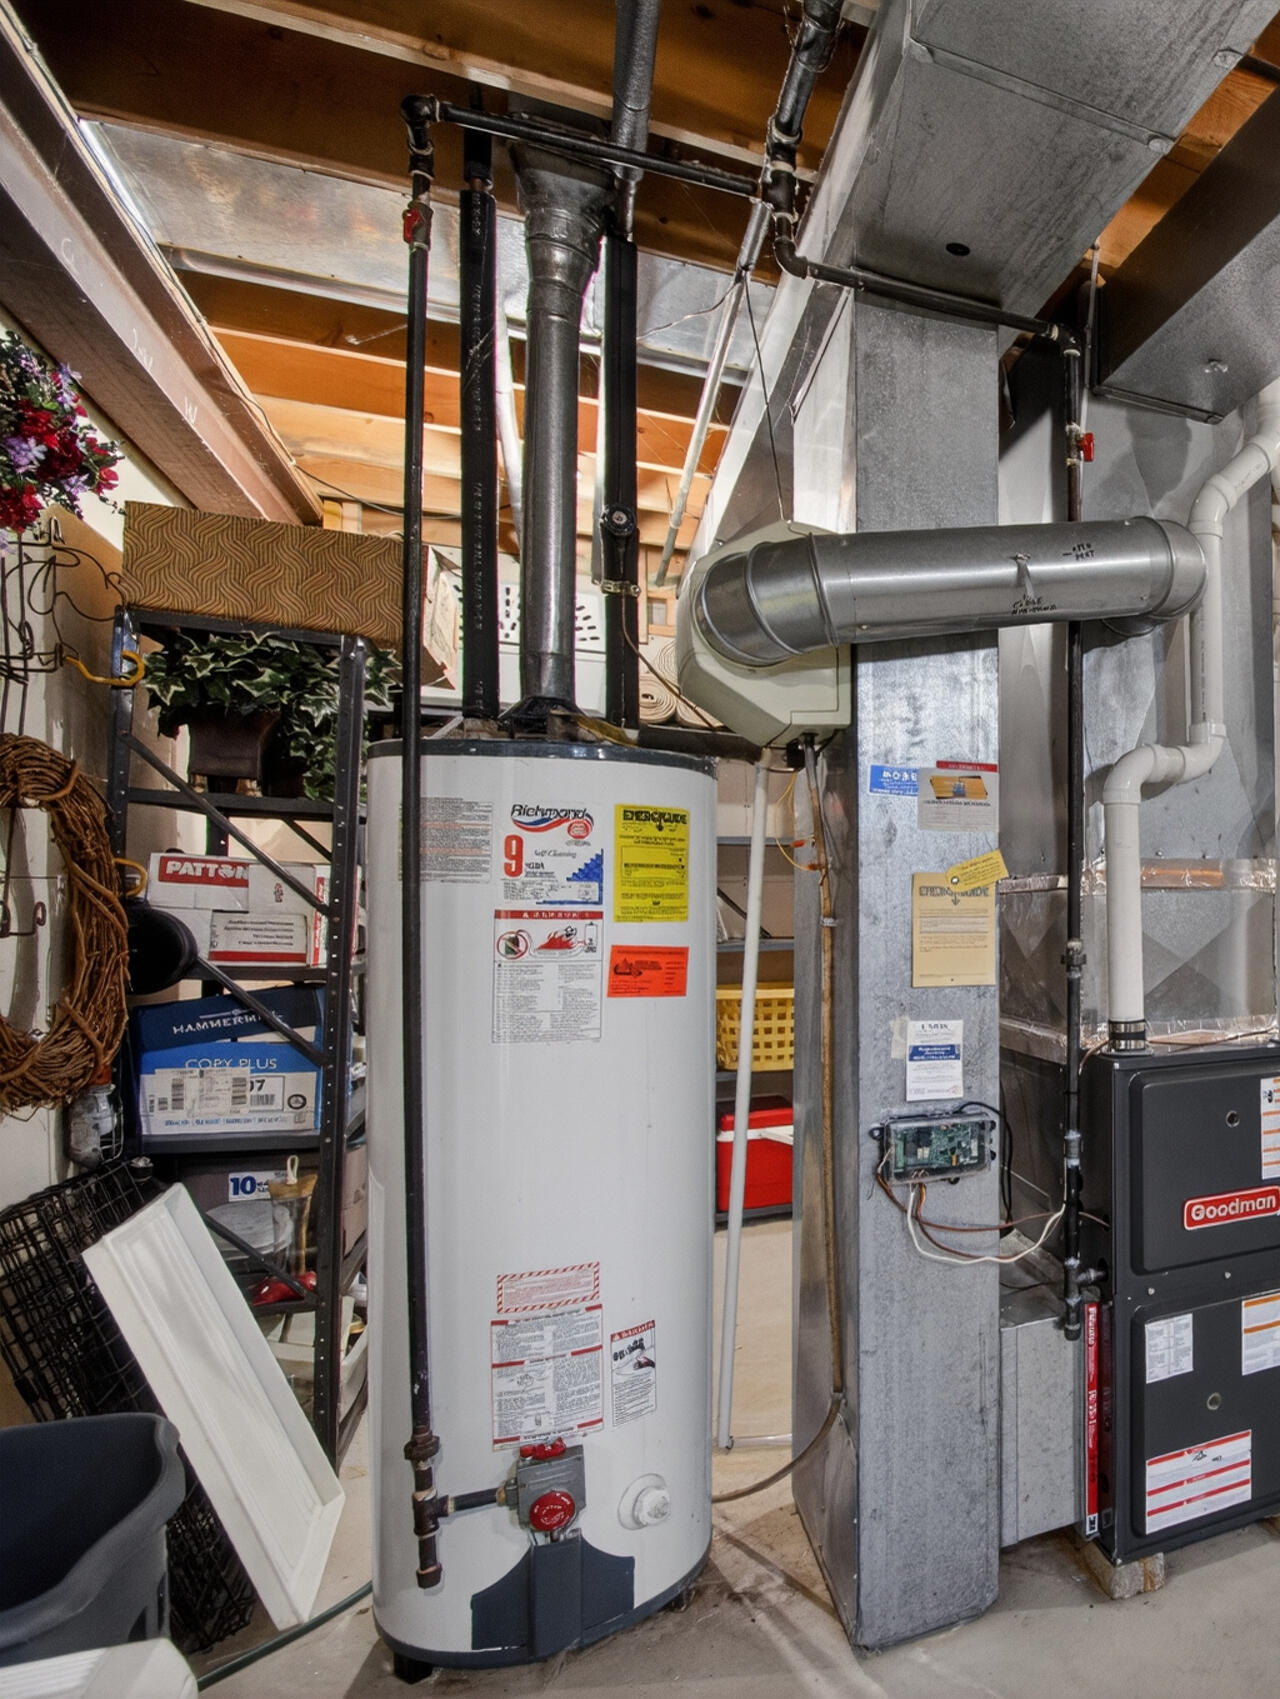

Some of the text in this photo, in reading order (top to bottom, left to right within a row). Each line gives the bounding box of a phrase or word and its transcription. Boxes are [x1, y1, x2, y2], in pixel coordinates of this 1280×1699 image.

[511, 804, 588, 820] Richmond
[503, 834, 524, 878] 9
[165, 860, 249, 880] PATTON
[185, 1058, 278, 1070] COPY PLUS
[230, 1175, 257, 1196] 10
[1191, 1195, 1276, 1221] Goodman
